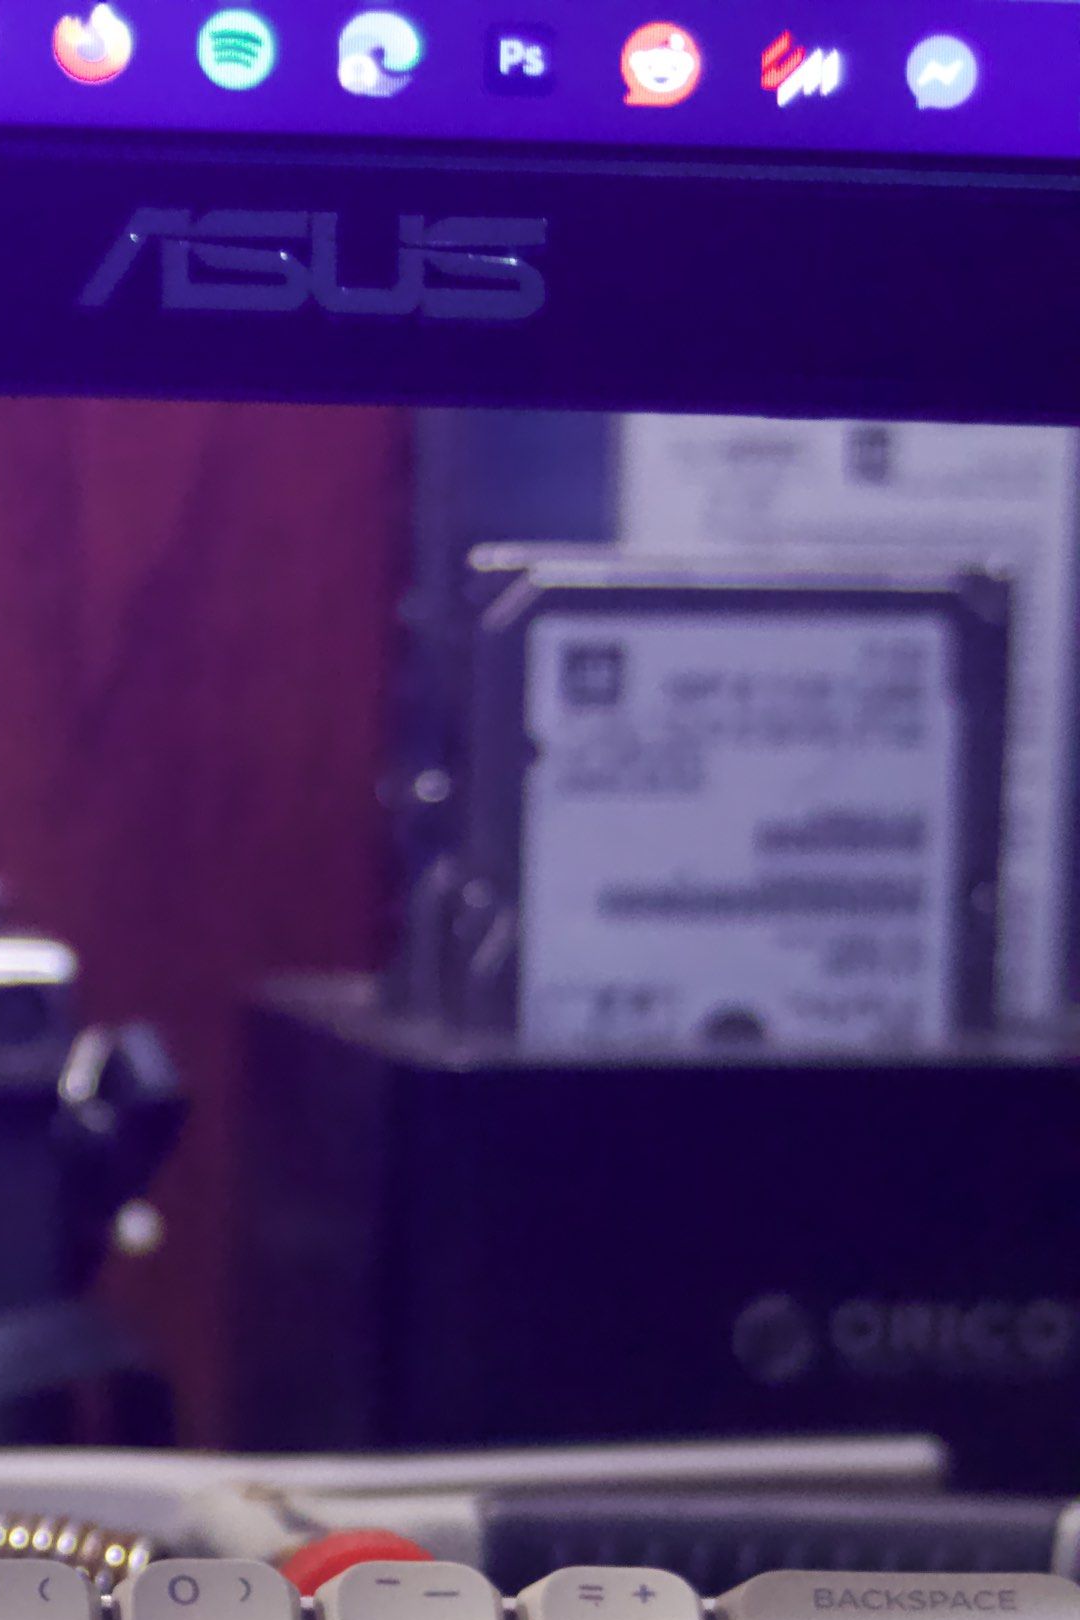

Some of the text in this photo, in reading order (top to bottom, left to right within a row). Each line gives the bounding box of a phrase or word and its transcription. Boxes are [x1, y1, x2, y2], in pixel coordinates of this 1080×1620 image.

[499, 38, 545, 77] Ps
[79, 207, 548, 319] ASUS
[167, 1573, 201, 1607] 0
[632, 1583, 656, 1604] +
[812, 1587, 1017, 1613] BACKSPACE
